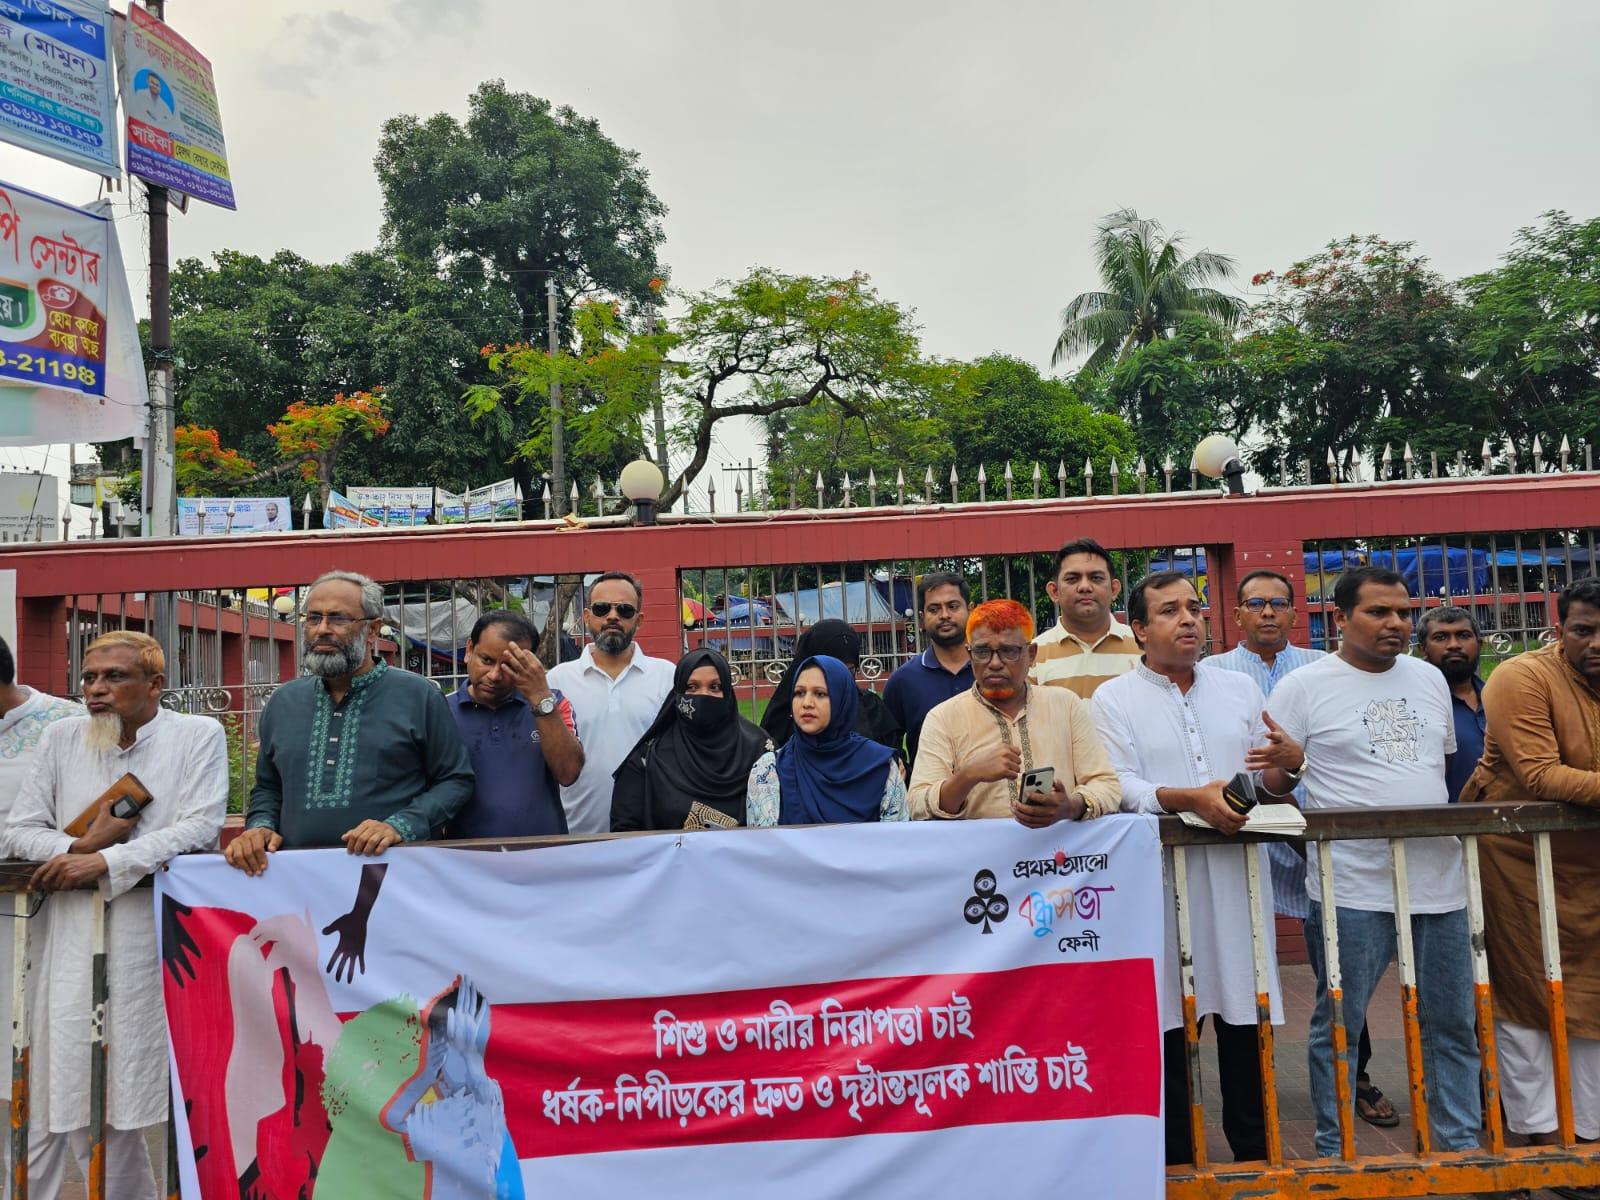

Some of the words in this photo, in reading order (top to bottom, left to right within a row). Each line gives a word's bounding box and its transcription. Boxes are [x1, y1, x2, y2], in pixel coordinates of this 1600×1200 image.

[80, 23, 97, 40] এ
[23, 32, 97, 80] (মামুন)
[30, 229, 102, 288] সেন্টার
[1367, 698, 1410, 722] ONE
[1366, 718, 1420, 744] LAST
[1380, 739, 1419, 764] TRY
[1013, 858, 1058, 879] প্রথম
[1058, 853, 1108, 877] আলো
[1018, 885, 1115, 938] বন্ধুসভা
[1058, 929, 1101, 953] ফেনী
[652, 1008, 708, 1059] শিশু
[715, 1018, 738, 1052] ও
[742, 999, 814, 1052] নারীর
[819, 996, 923, 1048] নিরাপত্তা
[928, 991, 975, 1040] চাই
[541, 1068, 746, 1129] ধর্ষক-নিপীড়কের
[751, 1075, 804, 1119] দ্রুত
[811, 1074, 834, 1110] ও
[838, 1058, 971, 1124] দৃষ্টান্তমূলক
[974, 1044, 1039, 1095] শাস্তি
[1043, 1041, 1093, 1094] চাই
